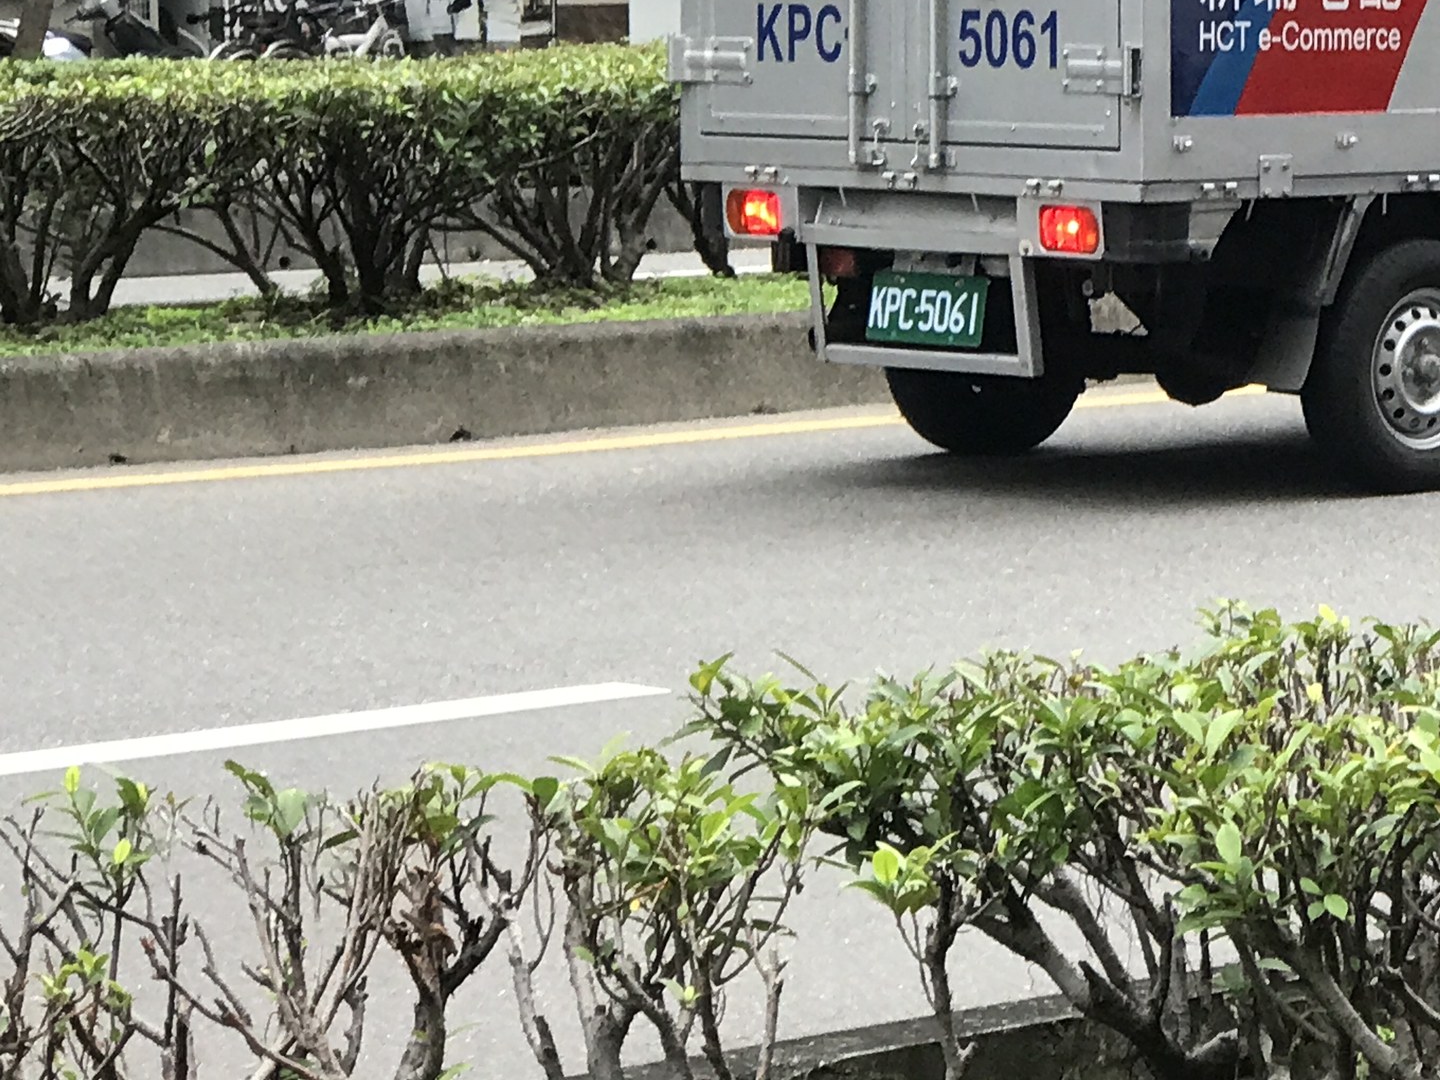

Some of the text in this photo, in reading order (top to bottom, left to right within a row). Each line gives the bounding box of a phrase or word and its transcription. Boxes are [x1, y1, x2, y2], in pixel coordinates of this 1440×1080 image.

[958, 9, 1059, 70] 5061
[1199, 18, 1401, 53] HCT e-Commerce
